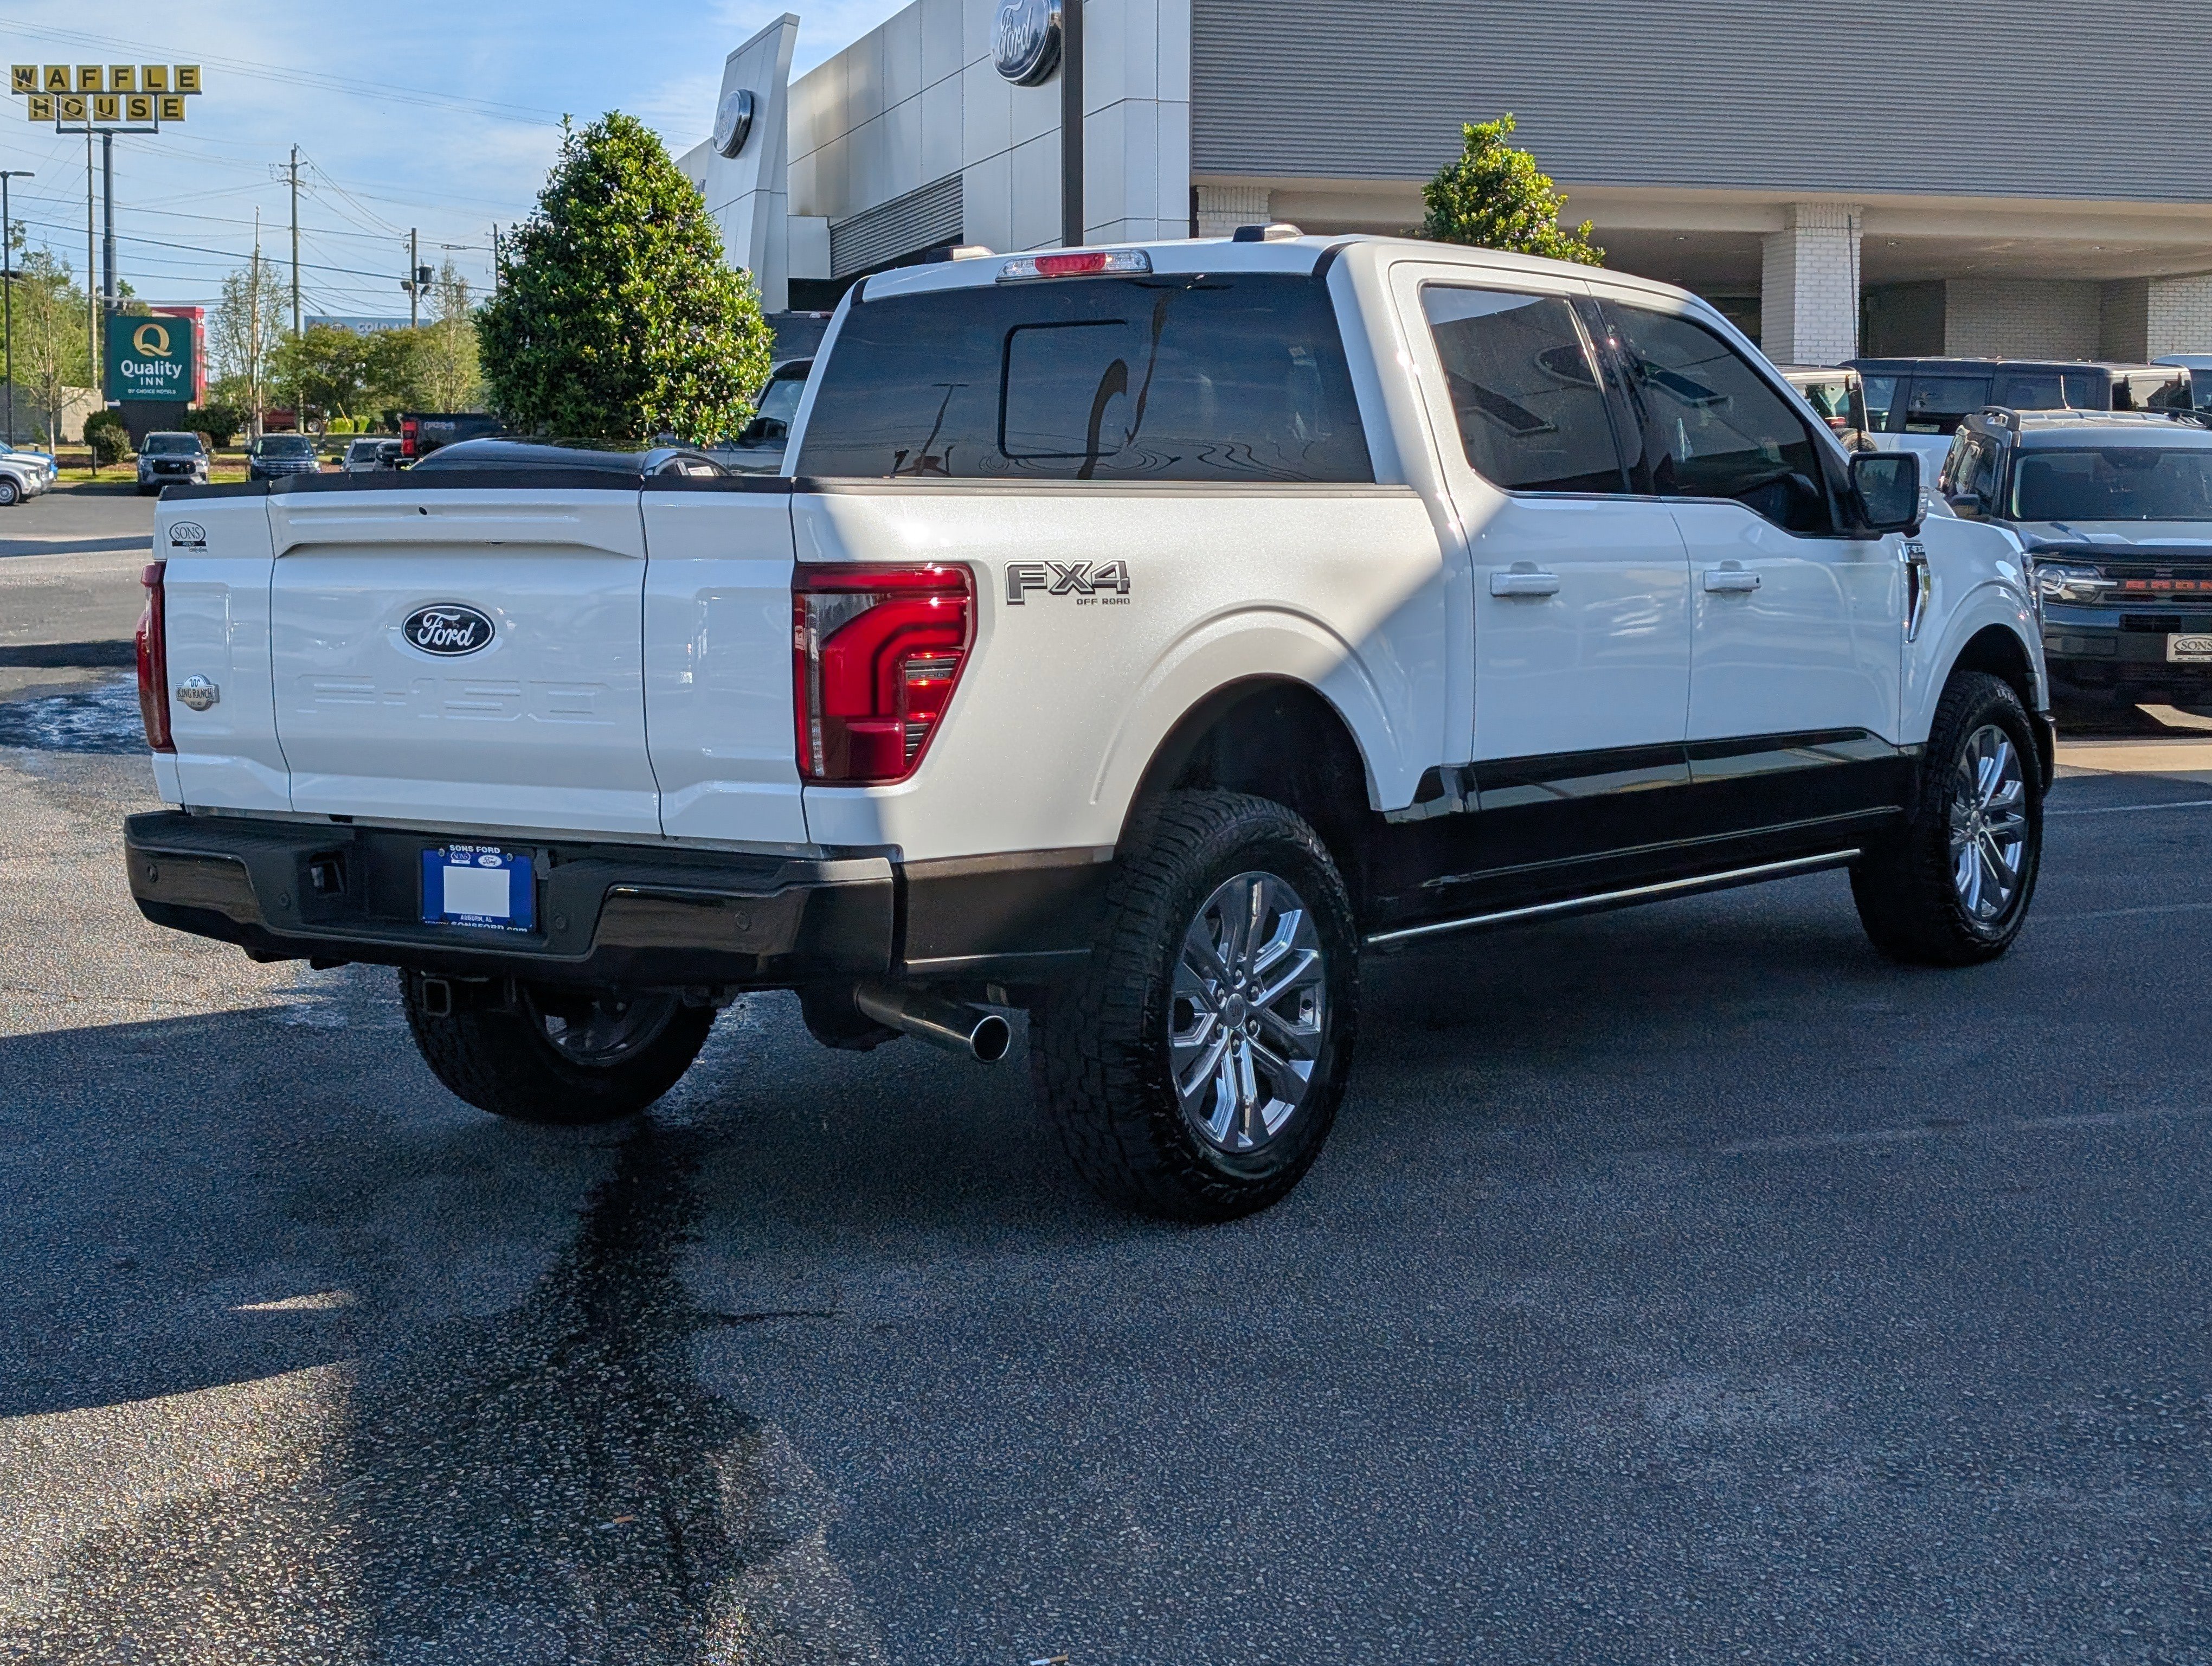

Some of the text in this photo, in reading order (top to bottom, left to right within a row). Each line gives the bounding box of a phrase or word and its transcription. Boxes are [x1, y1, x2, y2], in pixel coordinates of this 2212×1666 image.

[998, 0, 1033, 63] Ford
[15, 68, 195, 88] WAFFLE
[33, 99, 179, 117] HOUSE
[120, 360, 182, 379] Quality
[140, 377, 164, 386] INN
[175, 527, 201, 539] SONS
[1004, 560, 1130, 605] FX4
[417, 613, 474, 648] Ford
[2181, 641, 2212, 650] SONS
[177, 688, 213, 699] KING RANCH
